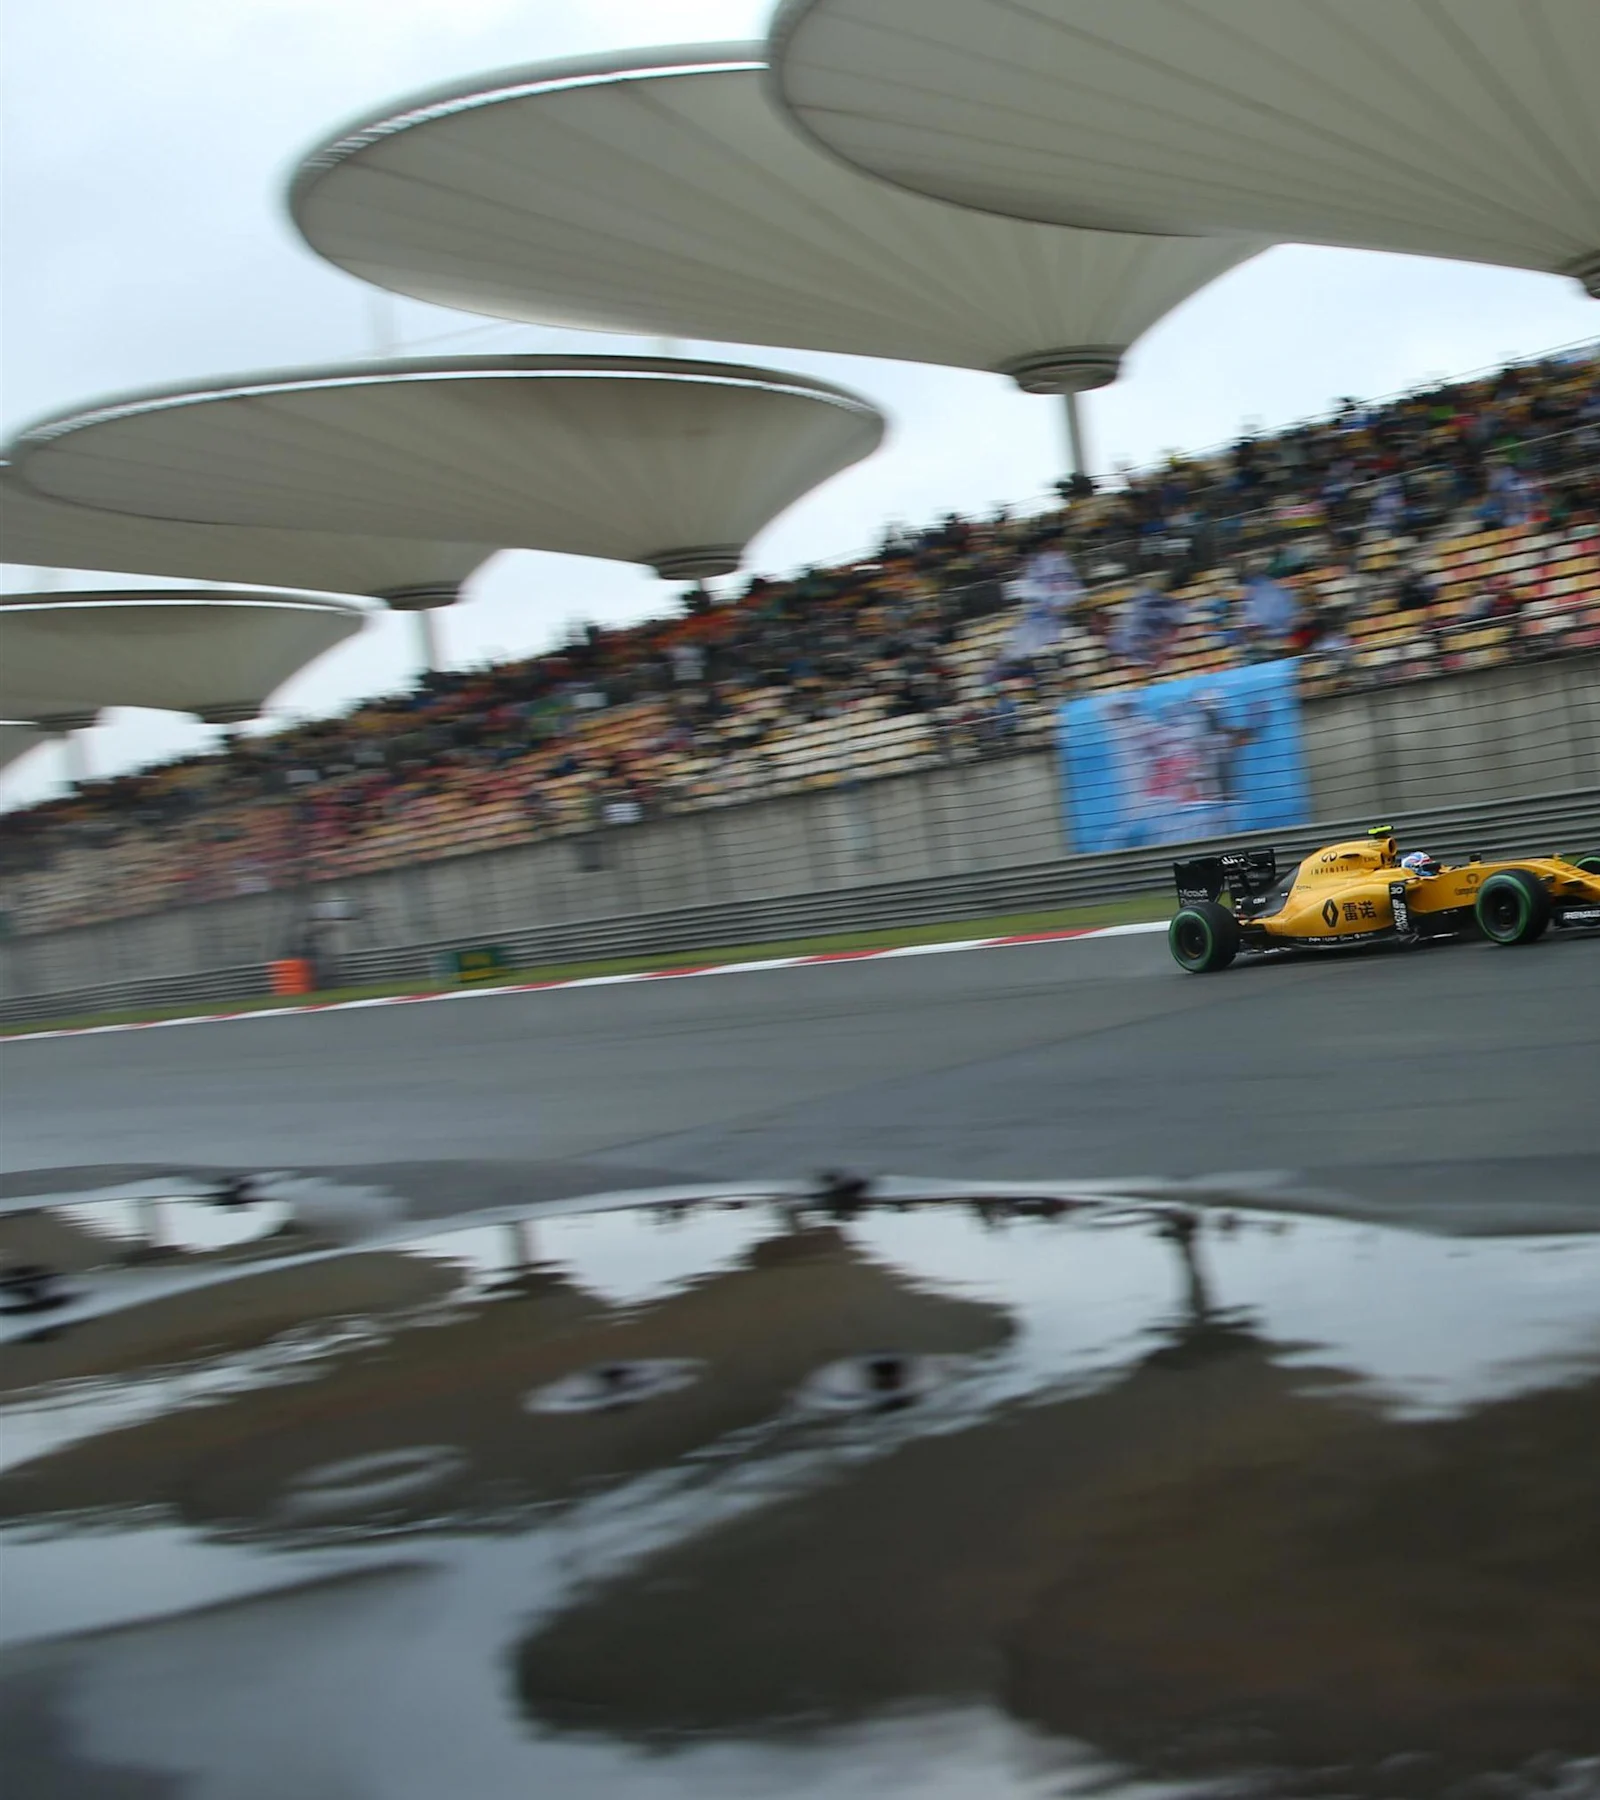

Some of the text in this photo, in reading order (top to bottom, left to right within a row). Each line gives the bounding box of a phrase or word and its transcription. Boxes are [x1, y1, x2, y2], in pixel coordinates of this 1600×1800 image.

[1310, 865, 1350, 875] INFINITI
[1390, 886, 1404, 895] 30
[1342, 900, 1377, 922] 雷诺
